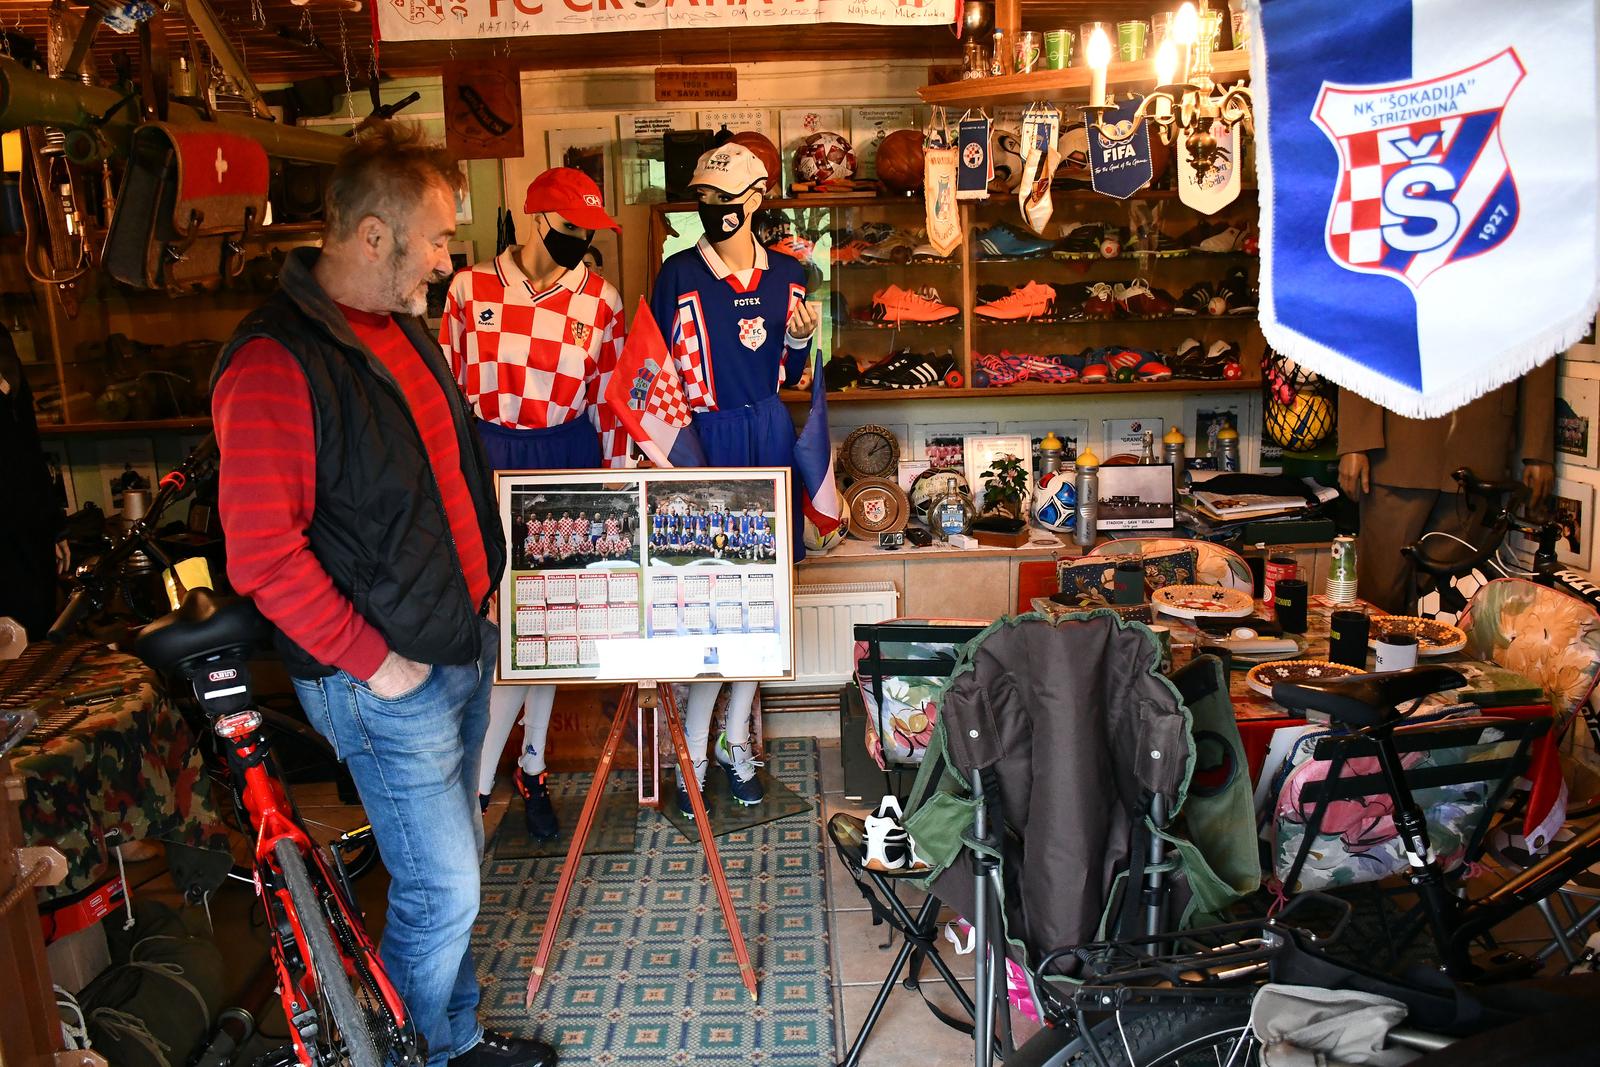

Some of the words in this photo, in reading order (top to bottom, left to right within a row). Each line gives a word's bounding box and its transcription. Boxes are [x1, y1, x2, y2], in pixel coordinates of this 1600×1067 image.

[1353, 101, 1376, 118] NK
[1379, 78, 1477, 111] "ŠOKADIJA"
[1370, 100, 1459, 128] STRIZIVOJNA
[1103, 143, 1136, 163] FIFA
[1380, 130, 1461, 253] Š
[1478, 203, 1510, 241] 1927
[734, 297, 761, 307] FOTEX
[752, 328, 762, 336] FC
[213, 670, 234, 680] ABUS
